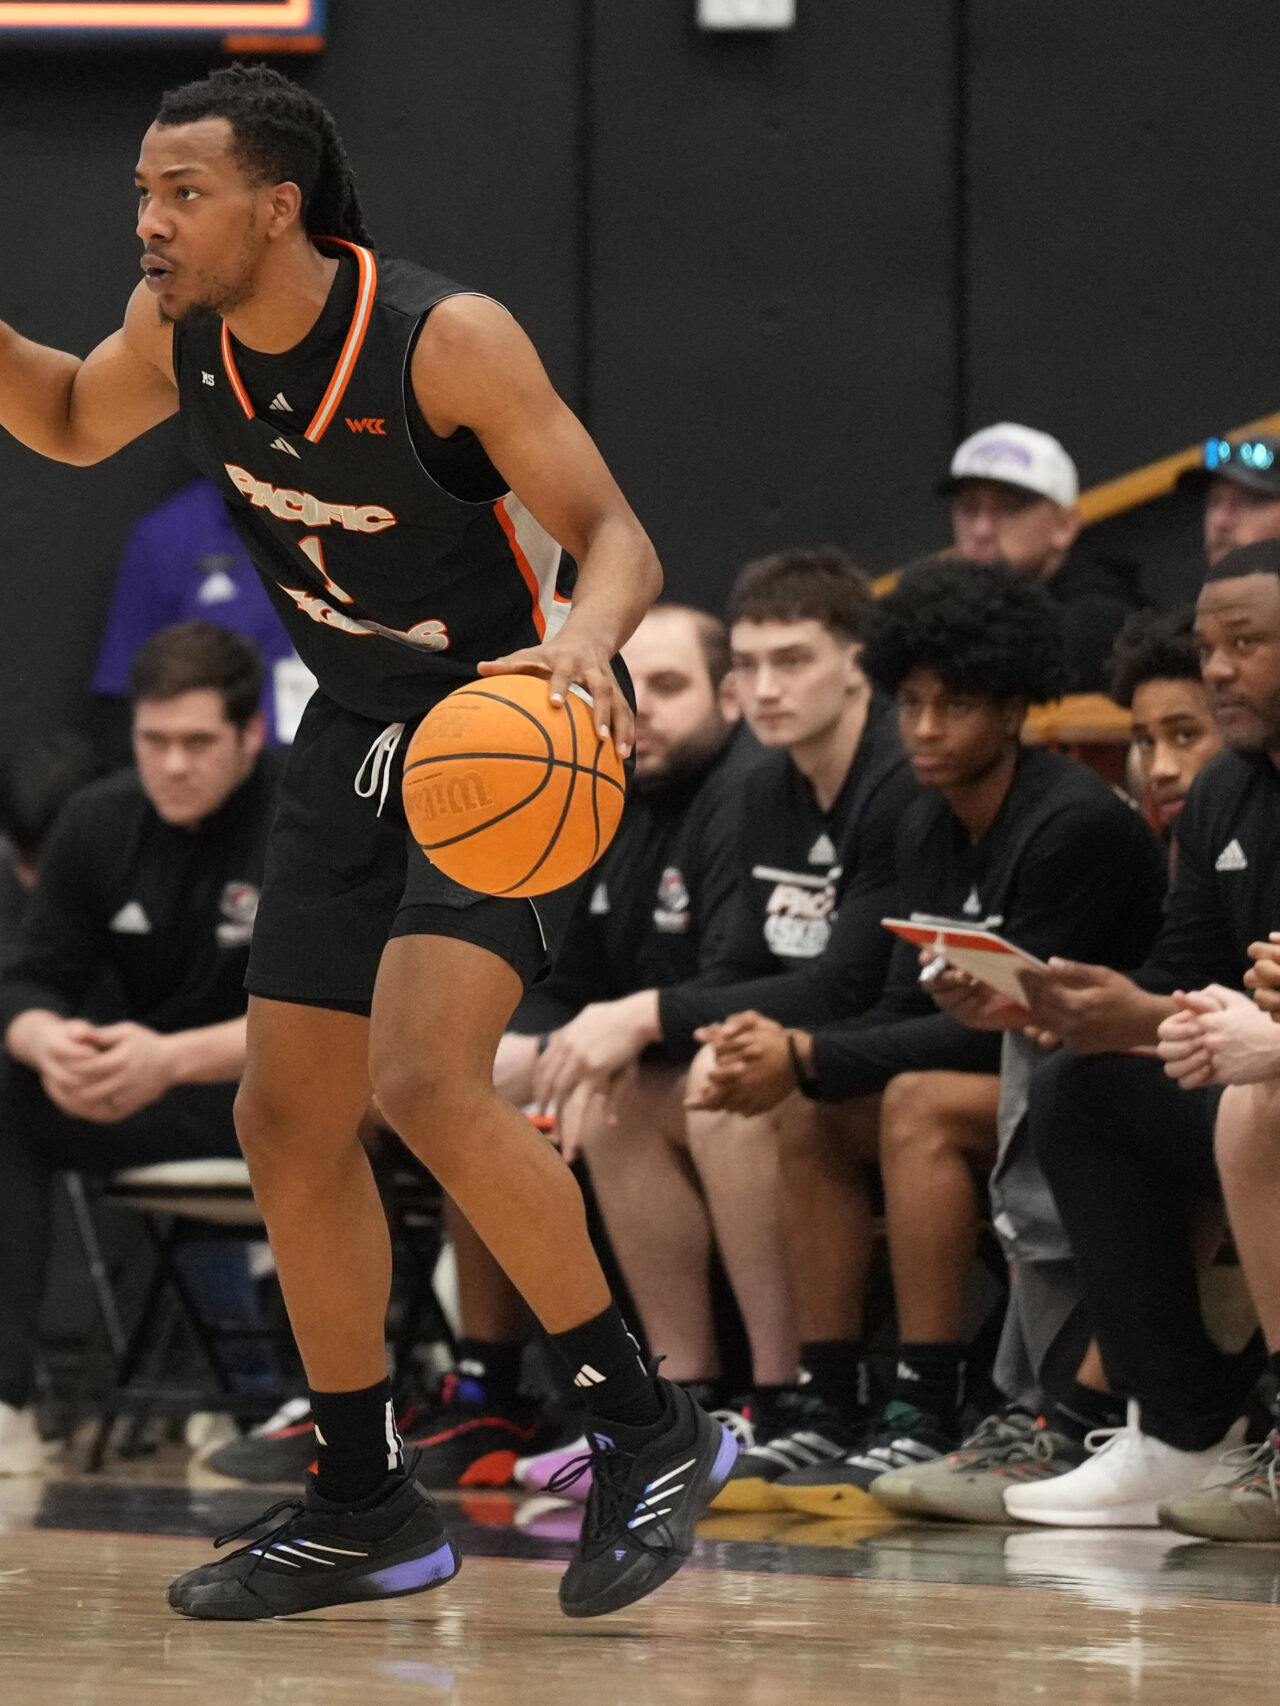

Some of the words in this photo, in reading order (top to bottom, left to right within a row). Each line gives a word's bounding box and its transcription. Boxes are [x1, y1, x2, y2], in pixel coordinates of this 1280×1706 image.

[344, 417, 387, 435] WCC
[224, 462, 398, 533] PACIFIC
[297, 535, 355, 603] 1
